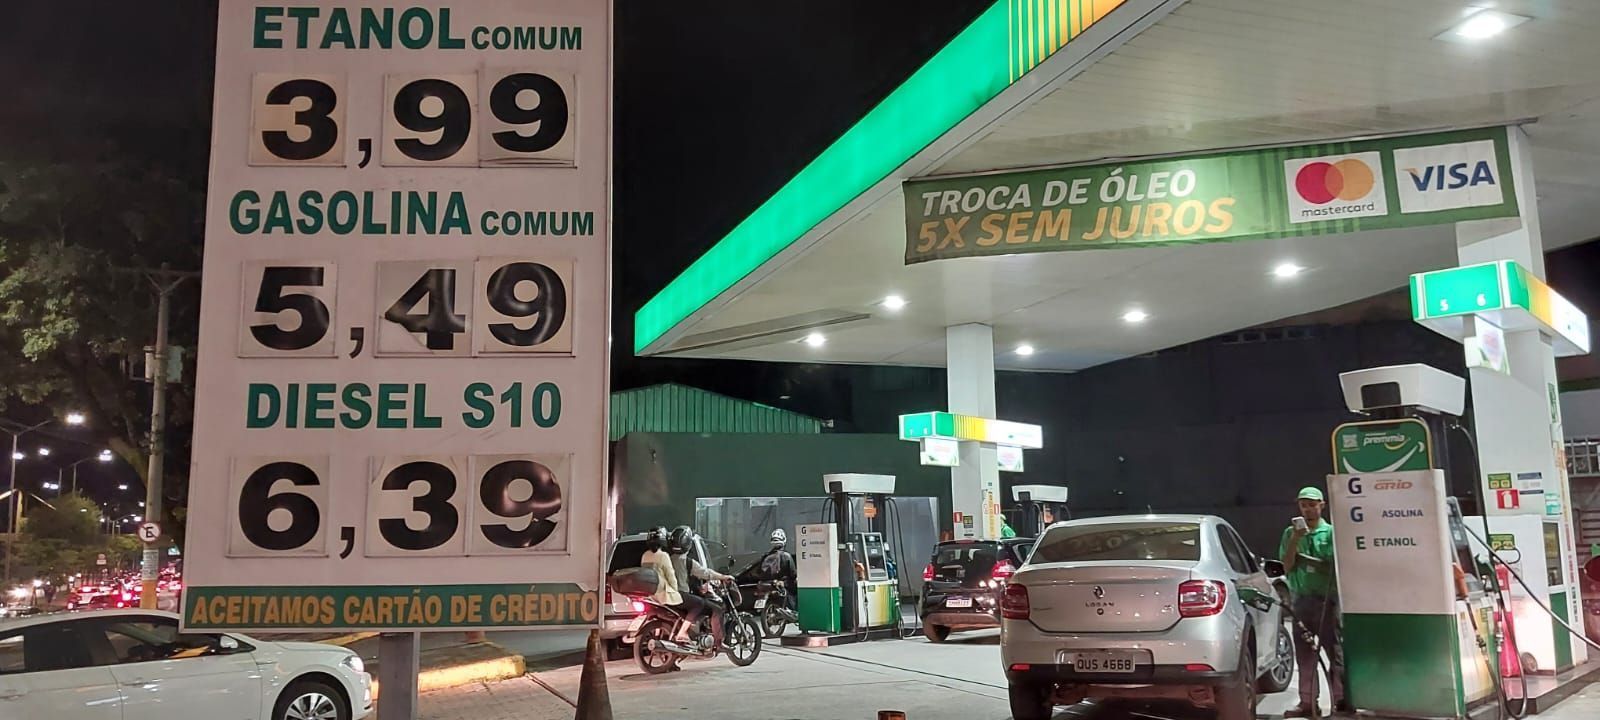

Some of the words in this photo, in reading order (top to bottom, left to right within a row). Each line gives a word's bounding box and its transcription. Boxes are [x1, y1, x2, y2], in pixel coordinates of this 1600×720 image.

[253, 7, 466, 49] ETANOL
[471, 26, 582, 50] COMUM
[261, 73, 569, 168] 3,99
[921, 184, 1031, 217] TROCA
[1042, 178, 1091, 207] DE
[1099, 167, 1196, 203] ÓLEO
[1402, 160, 1496, 192] VISA
[229, 190, 472, 235] GASOLINA
[480, 211, 594, 236] COMUM
[916, 216, 971, 252] 5X
[975, 209, 1072, 246] SEM
[1082, 198, 1236, 240] JUROS
[1301, 202, 1375, 217] mastercard
[249, 262, 567, 358] 5,49
[1476, 293, 1486, 307] 6
[246, 383, 443, 429] DIESEL
[461, 382, 562, 429] S10
[1348, 477, 1362, 495] G
[238, 460, 562, 559] 6,39
[1350, 506, 1364, 523] G
[1355, 536, 1366, 550] E
[1373, 537, 1417, 547] ETANOL
[191, 595, 336, 625] ACEITAMOS
[343, 589, 442, 624] CARTÃO
[449, 596, 482, 623] DE
[490, 585, 598, 623] CRÉDITO
